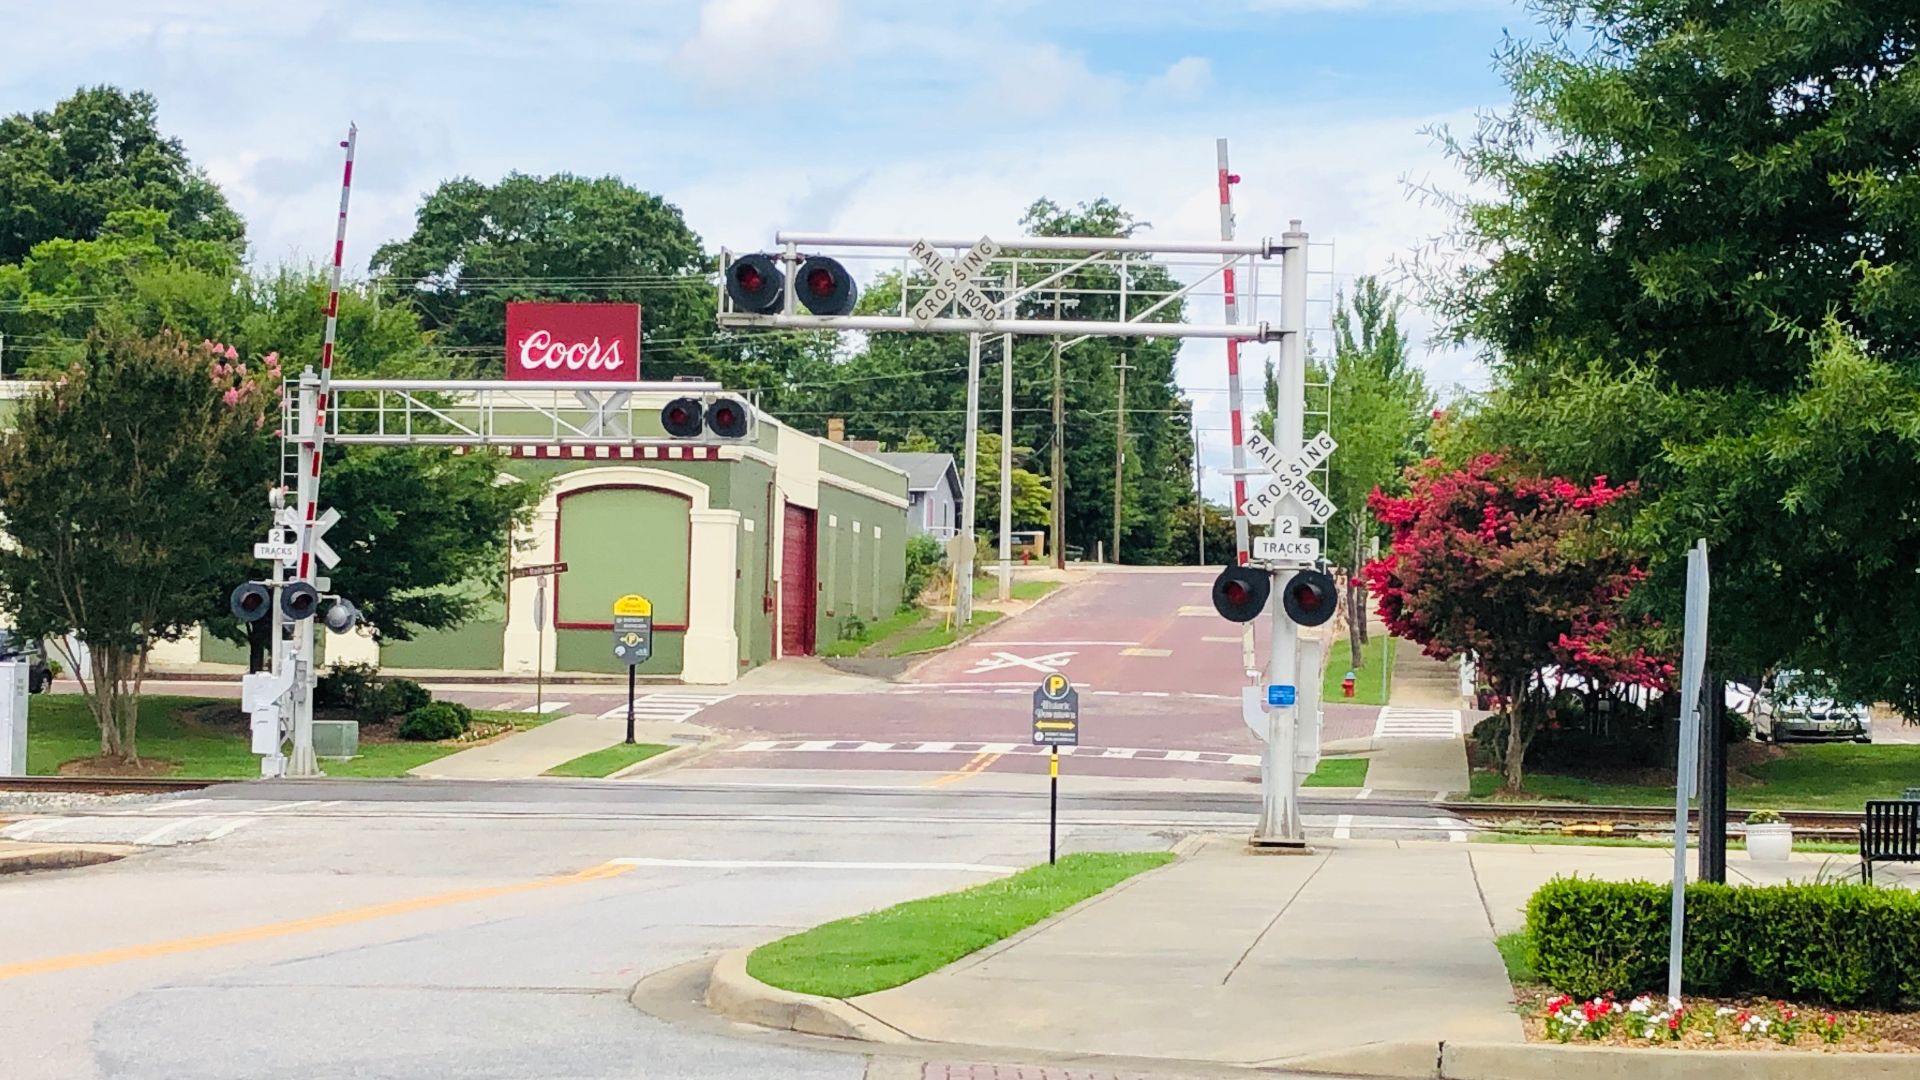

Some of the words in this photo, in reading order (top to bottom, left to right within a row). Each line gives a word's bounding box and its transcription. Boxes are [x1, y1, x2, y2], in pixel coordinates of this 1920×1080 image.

[916, 242, 992, 321] CROSSING
[518, 329, 624, 370] Coors
[1247, 437, 1332, 517] CROSSING
[1282, 519, 1292, 534] 2
[273, 531, 280, 542] 2
[260, 547, 292, 555] TRACKS
[1263, 542, 1311, 554] TRACKS
[1050, 676, 1064, 696] P
